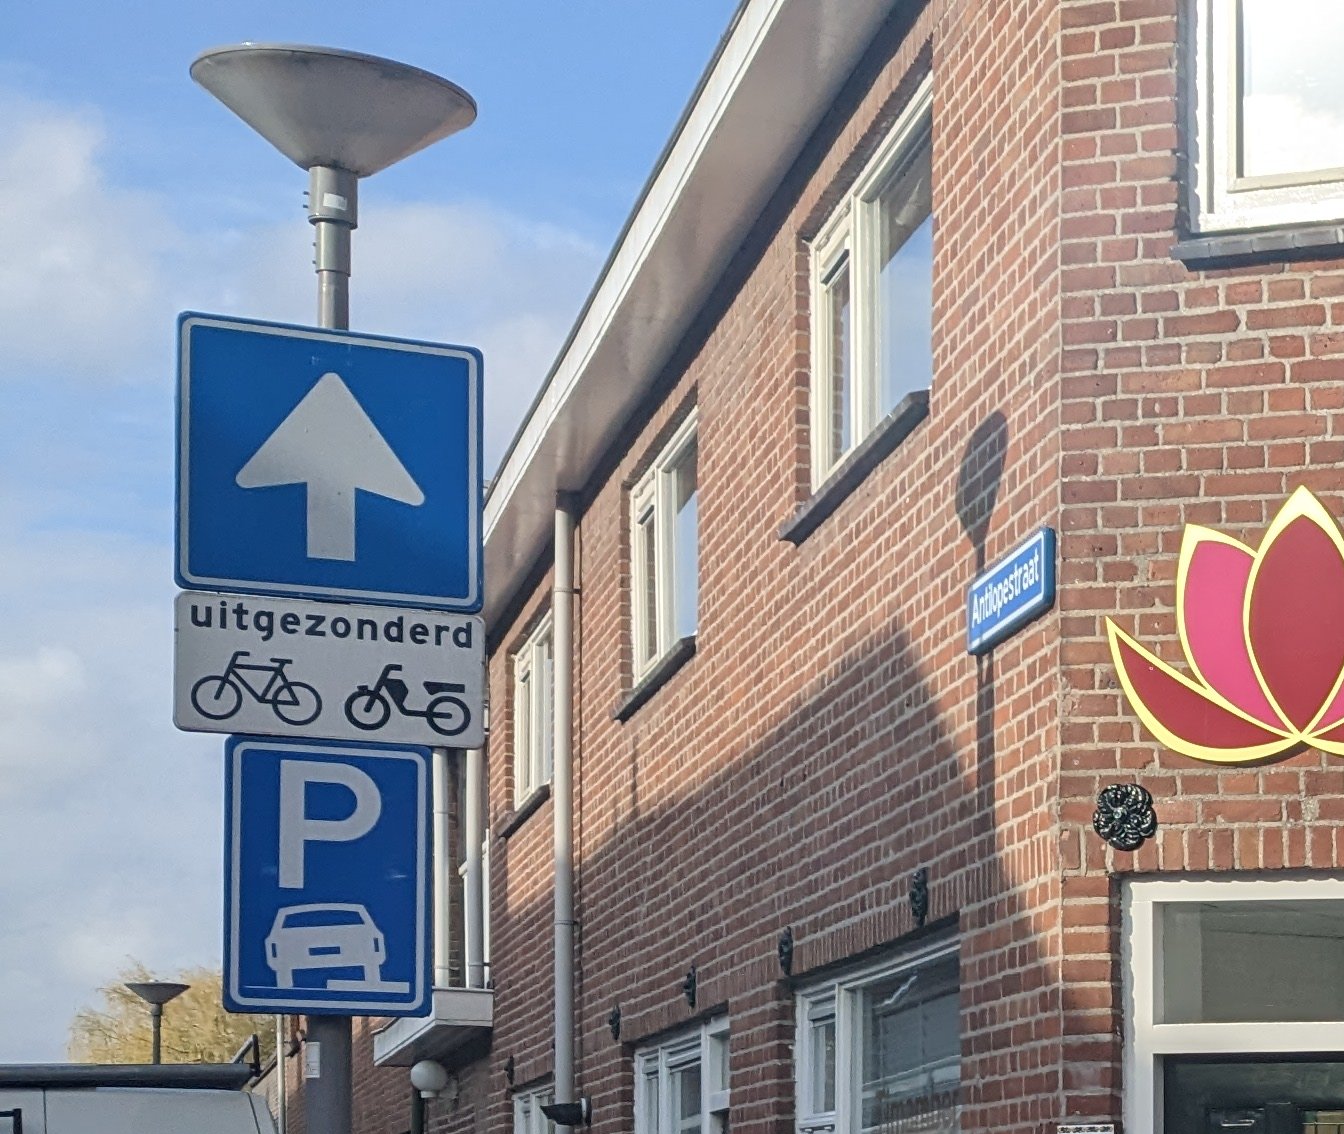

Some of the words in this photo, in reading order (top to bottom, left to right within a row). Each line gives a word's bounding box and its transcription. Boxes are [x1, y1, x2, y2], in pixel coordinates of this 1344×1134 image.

[190, 601, 473, 648] uitgezonderd
[971, 547, 1039, 629] Antilopestraat
[279, 759, 382, 889] P
